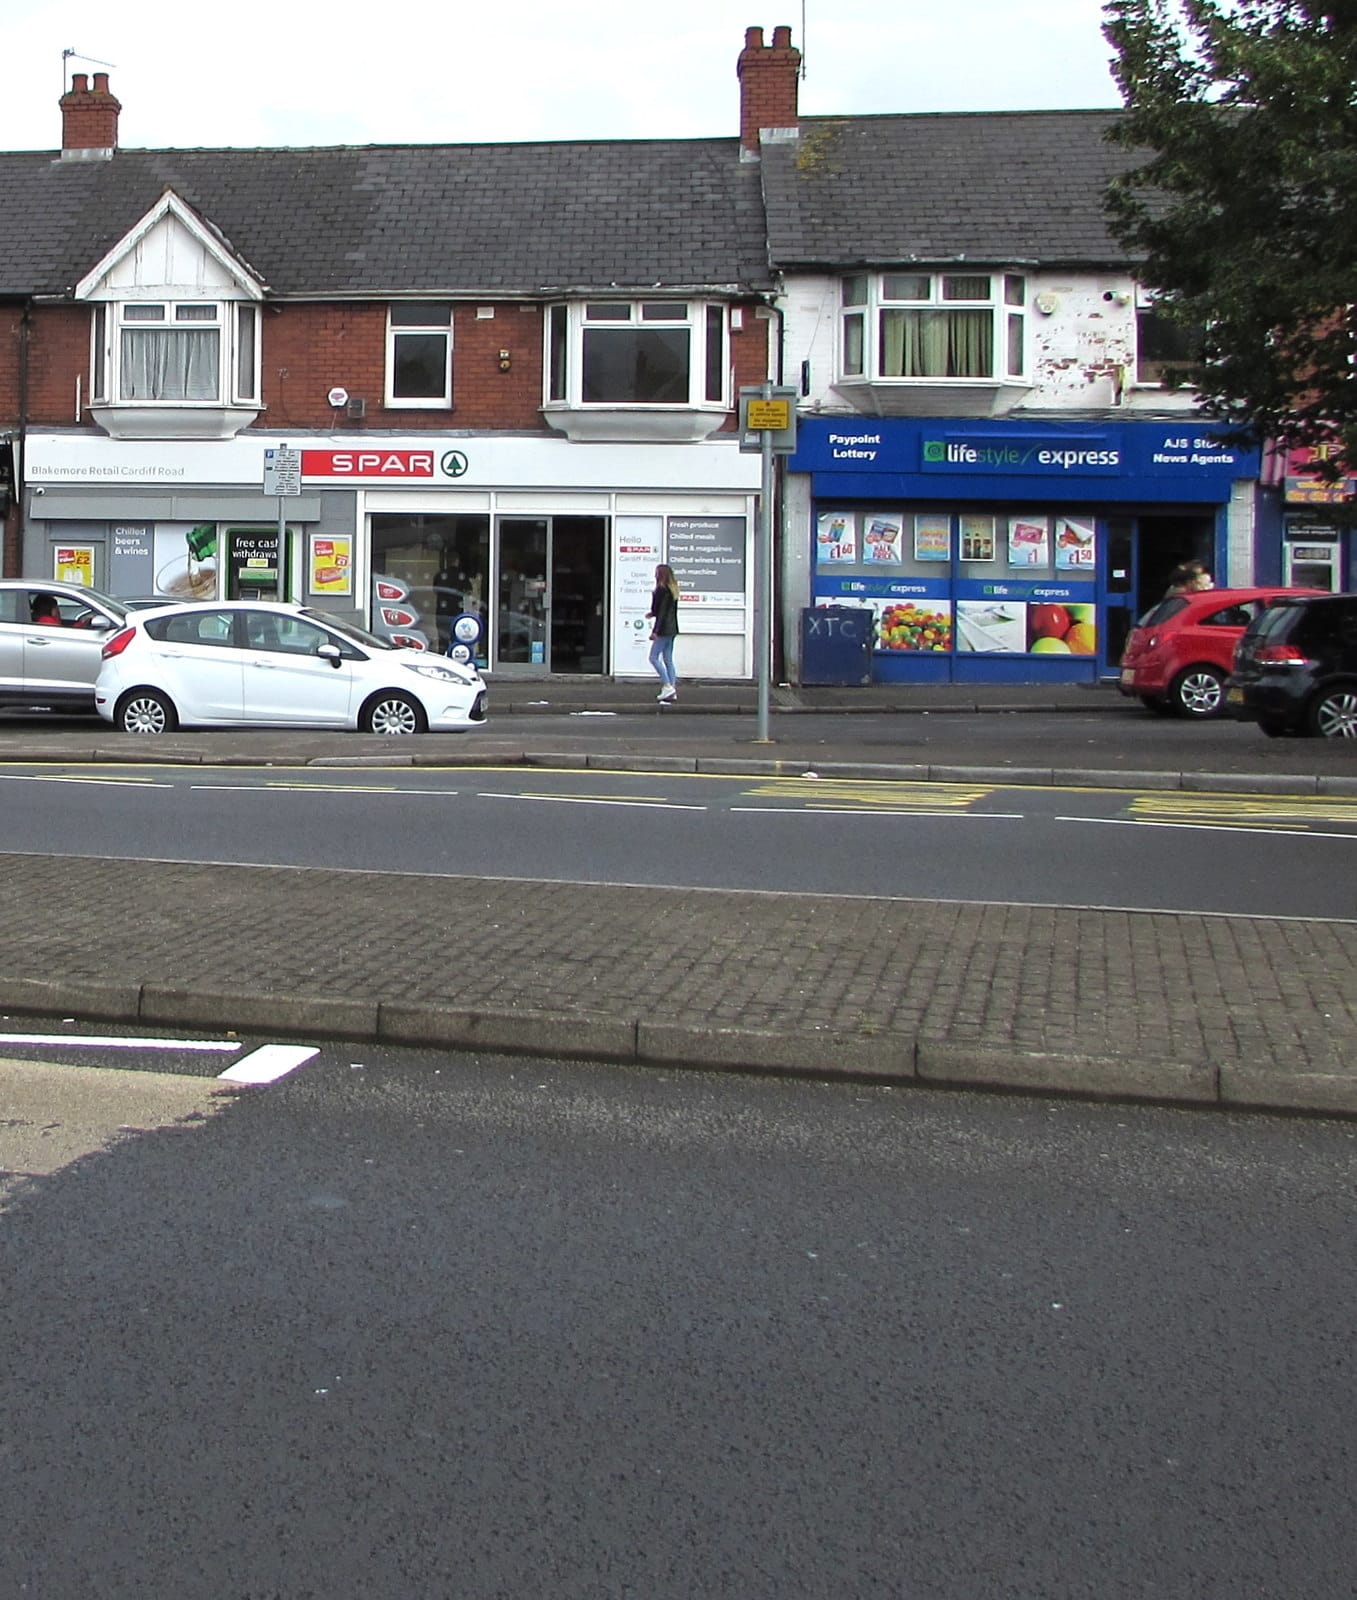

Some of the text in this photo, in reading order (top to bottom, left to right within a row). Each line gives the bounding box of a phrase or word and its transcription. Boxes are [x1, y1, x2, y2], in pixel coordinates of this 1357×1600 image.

[829, 434, 881, 446] Paypoint
[1163, 438, 1188, 448] AJS
[833, 449, 876, 461] Lottery
[947, 444, 1119, 468] lifestyle express
[1153, 454, 1234, 465] News Agents
[332, 454, 431, 472] SPAR
[32, 466, 184, 476] Blakemore Retail Cardiff Road
[115, 527, 146, 536] Chilled
[115, 536, 140, 545] beers
[236, 537, 255, 548] free
[115, 546, 149, 555] & wines
[890, 585, 927, 593] express
[1034, 588, 1069, 597] express
[808, 616, 857, 637] XTC
